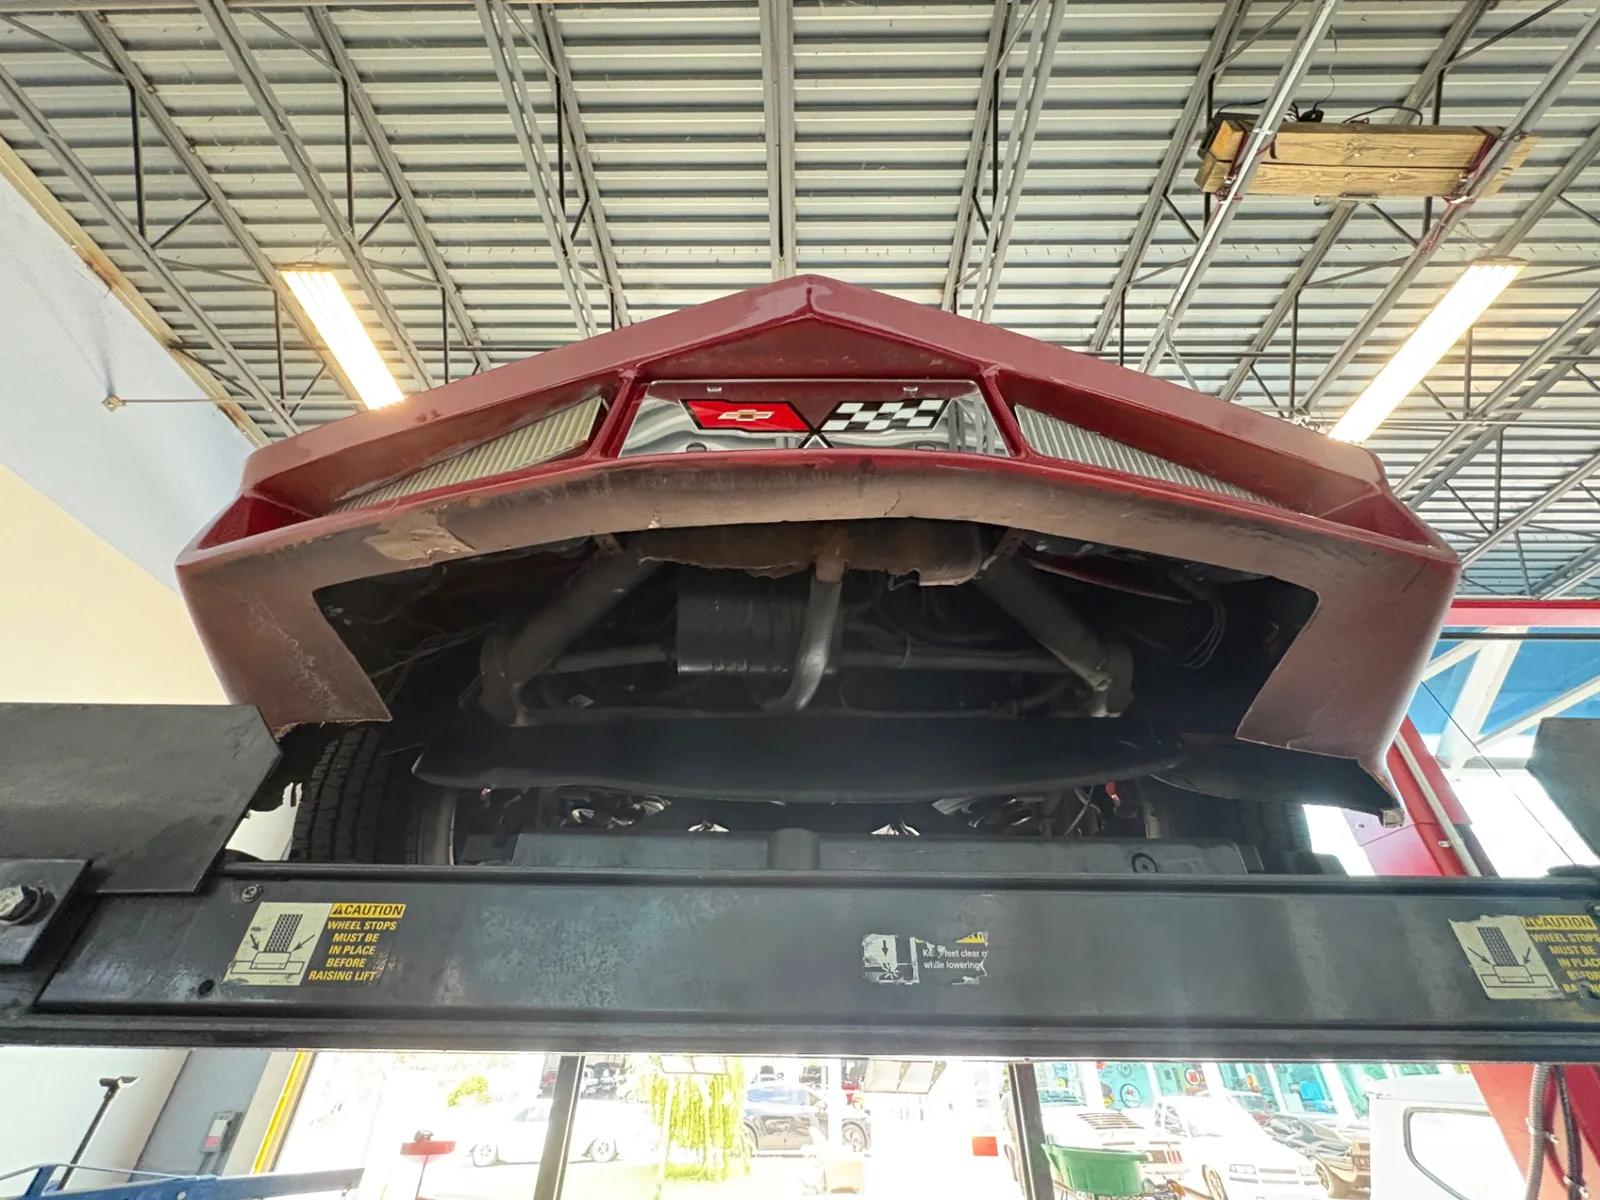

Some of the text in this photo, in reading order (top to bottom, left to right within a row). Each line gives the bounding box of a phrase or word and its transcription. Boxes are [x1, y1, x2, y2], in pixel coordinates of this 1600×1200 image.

[344, 904, 403, 915] CAUTION
[327, 920, 397, 931] WHEEL STOPS
[1533, 916, 1594, 928] CAUTION
[333, 933, 380, 943] MUST BE
[329, 945, 376, 955] IN PLACE
[960, 949, 980, 957] clear
[326, 958, 366, 968] BEFORE
[946, 960, 981, 971] lowering
[308, 971, 377, 981] RAISING LIFT
